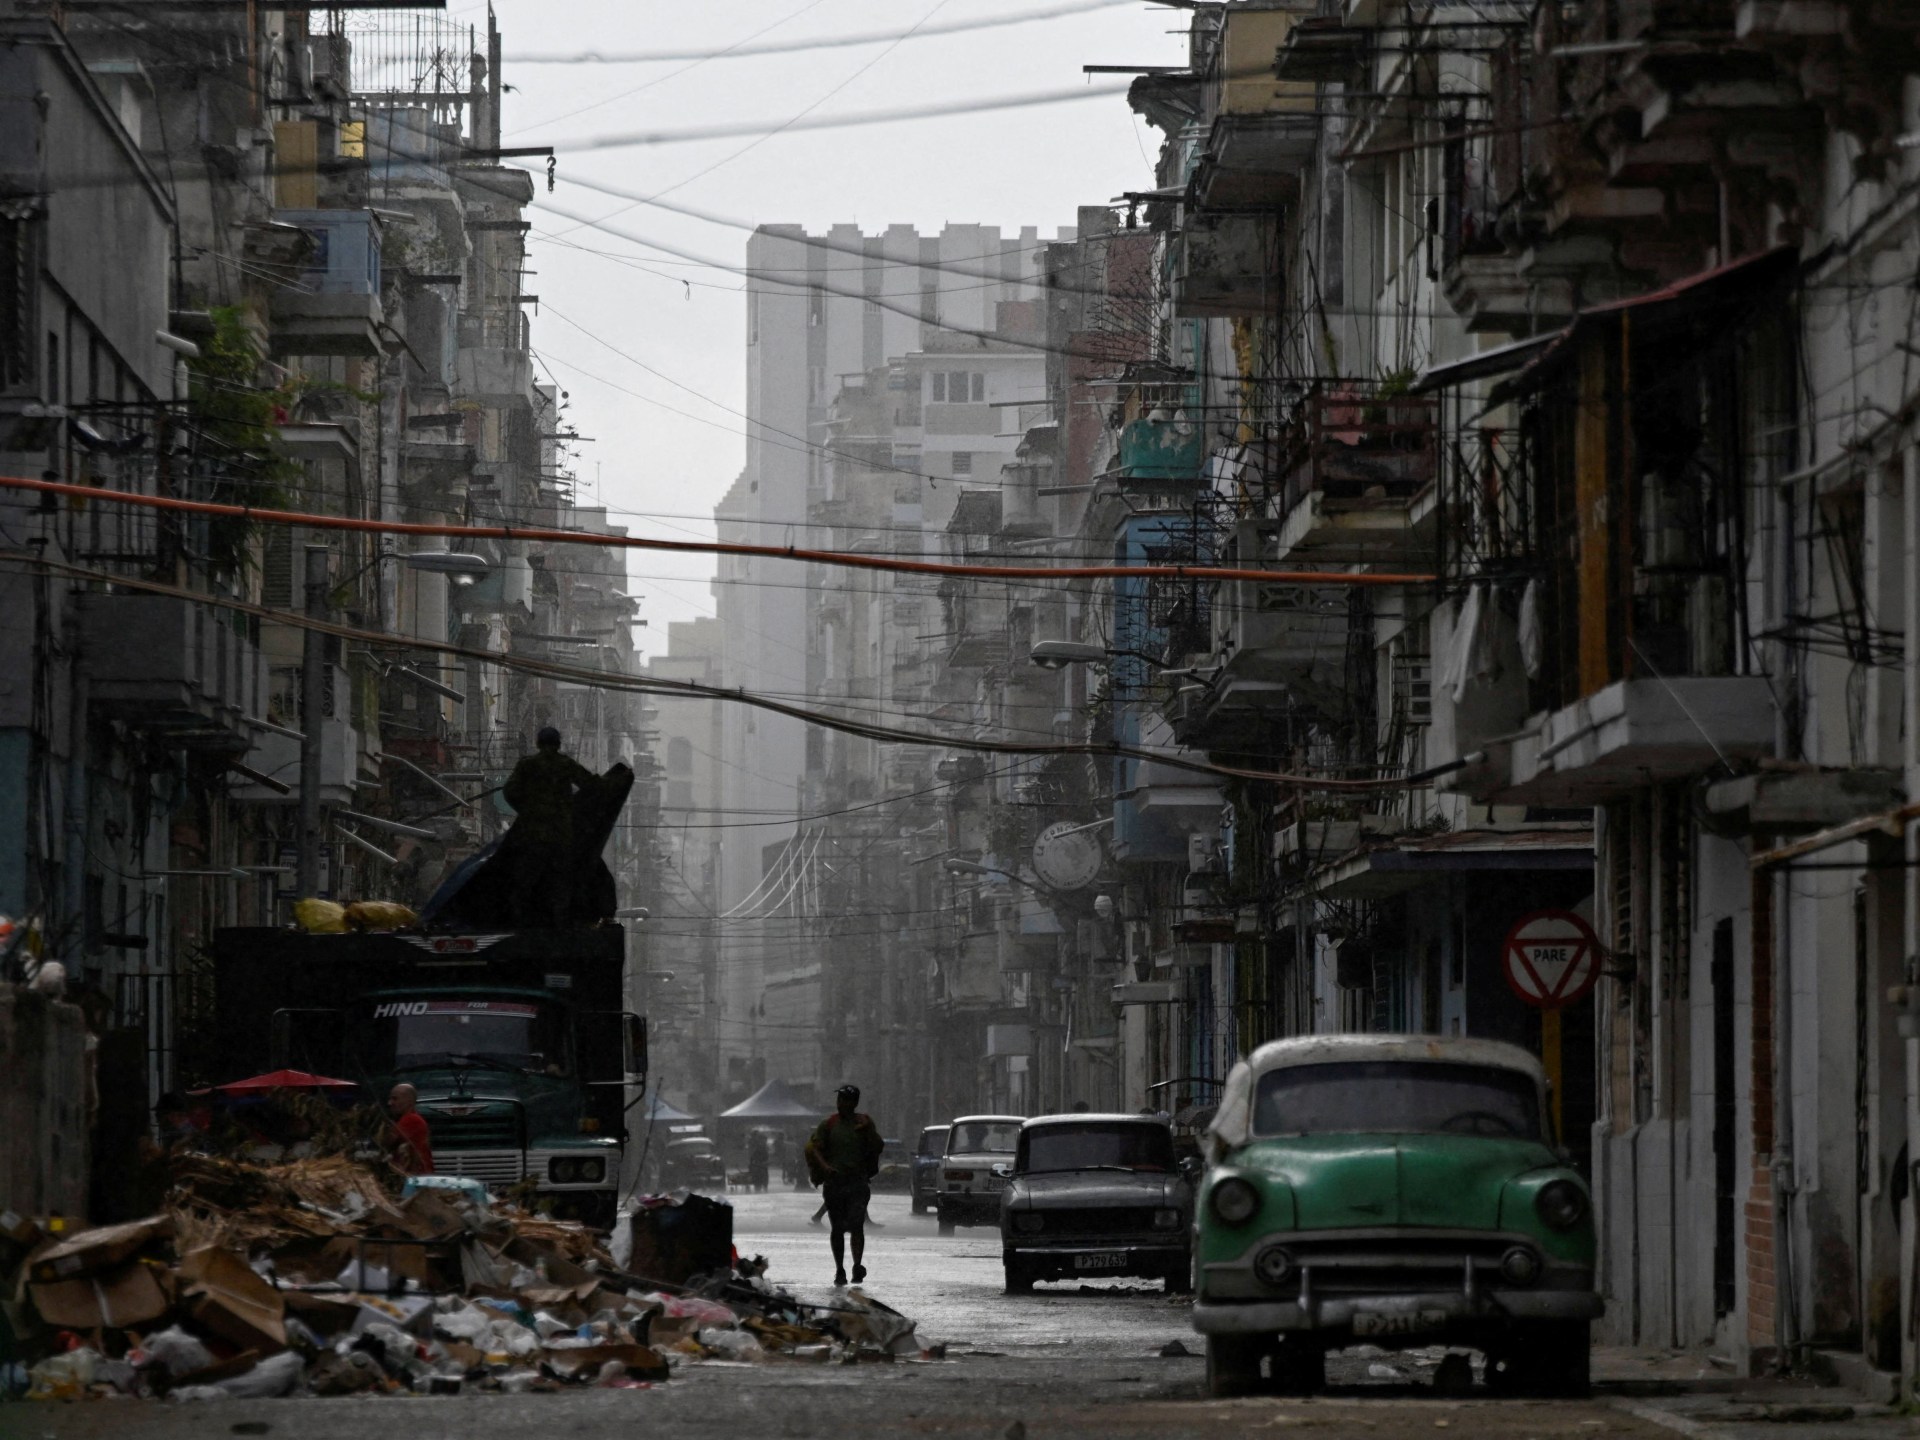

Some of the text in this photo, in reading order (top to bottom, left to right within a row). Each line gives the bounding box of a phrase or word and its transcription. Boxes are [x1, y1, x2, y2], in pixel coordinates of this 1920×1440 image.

[1534, 949, 1567, 962] PARE
[373, 1002, 428, 1019] HINO
[467, 1001, 489, 1009] FOR
